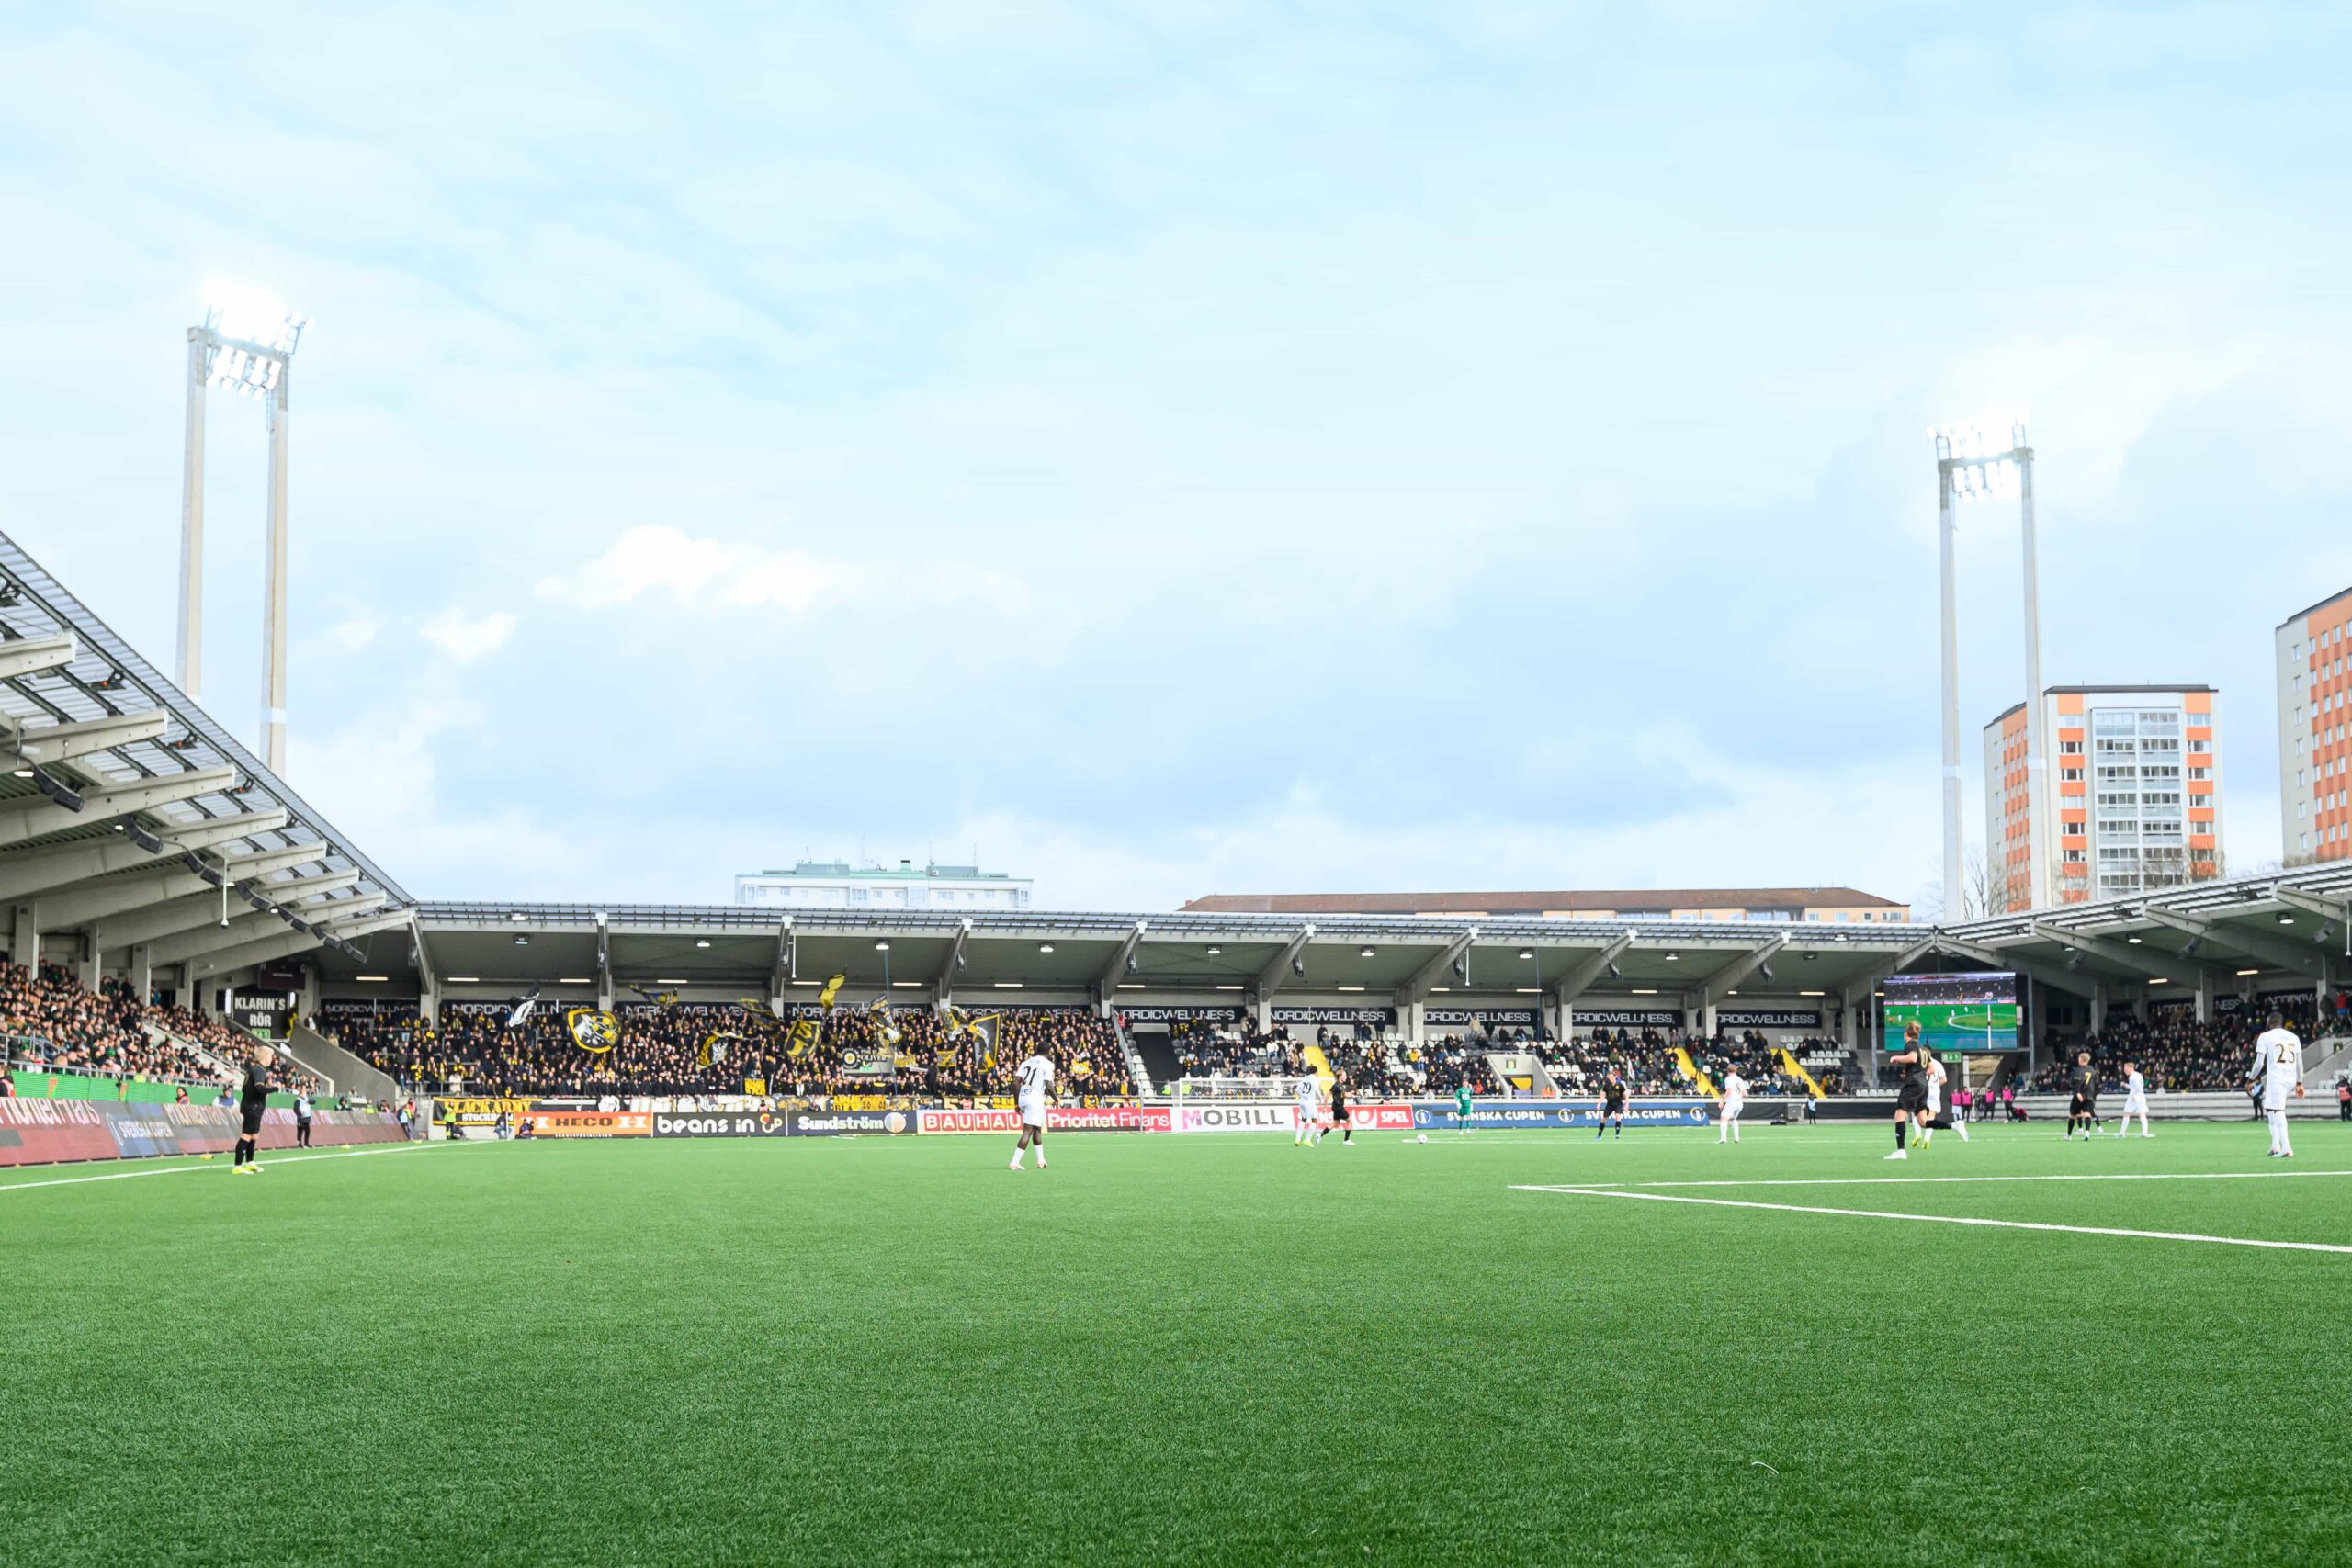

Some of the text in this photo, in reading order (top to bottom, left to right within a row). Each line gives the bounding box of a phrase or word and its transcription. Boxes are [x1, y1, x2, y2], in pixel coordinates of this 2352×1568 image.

[249, 1011, 272, 1027] RÖR
[1423, 1011, 1531, 1021] ORDICWELLNESS
[1572, 1013, 1673, 1023] ORDICWELLNESS
[1716, 1014, 1815, 1023] ORDICWELLNESS
[2275, 1043, 2296, 1064] 25
[1022, 1066, 1037, 1086] 21
[2085, 1072, 2092, 1086] 7
[555, 1118, 613, 1126] HECO
[925, 1114, 1023, 1130] BAUHAU
[1047, 1113, 1117, 1128] Prioritet
[1182, 1110, 1284, 1129] MOBILL
[1380, 1111, 1409, 1123] SPEL
[1505, 1111, 1545, 1121] CUPEN
[1585, 1110, 1681, 1121] SVKA CUPEN
[657, 1115, 729, 1134] beans
[735, 1118, 755, 1133] in
[797, 1116, 884, 1130] Sundström
